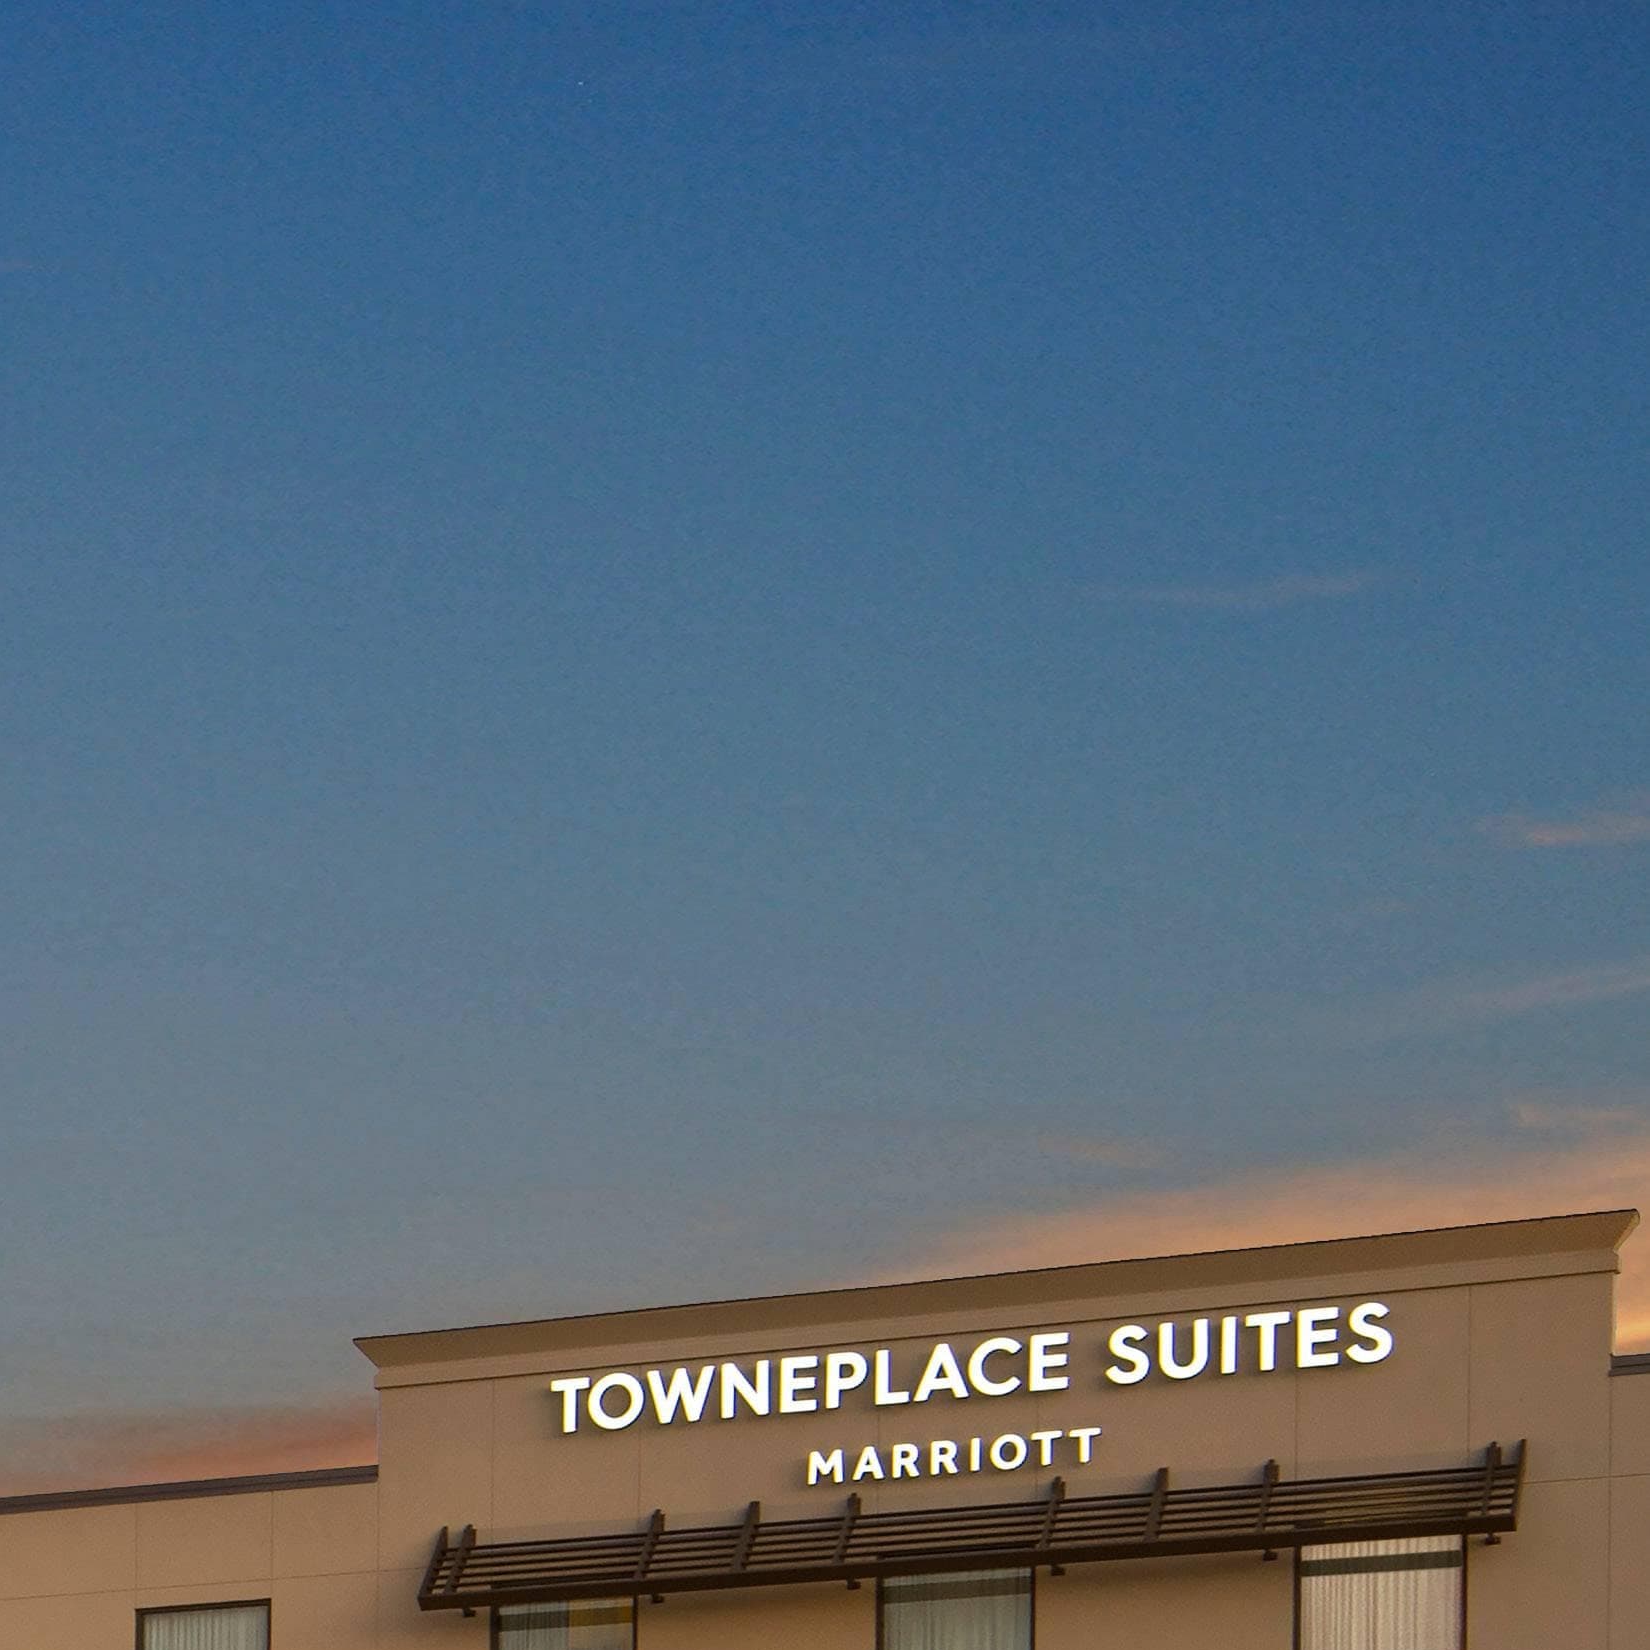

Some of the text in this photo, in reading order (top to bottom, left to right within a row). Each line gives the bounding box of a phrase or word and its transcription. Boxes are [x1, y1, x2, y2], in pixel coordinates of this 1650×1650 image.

[549, 1301, 1394, 1434] TOWNEPLACE SUITES
[807, 1426, 1102, 1486] MARRIOTT
